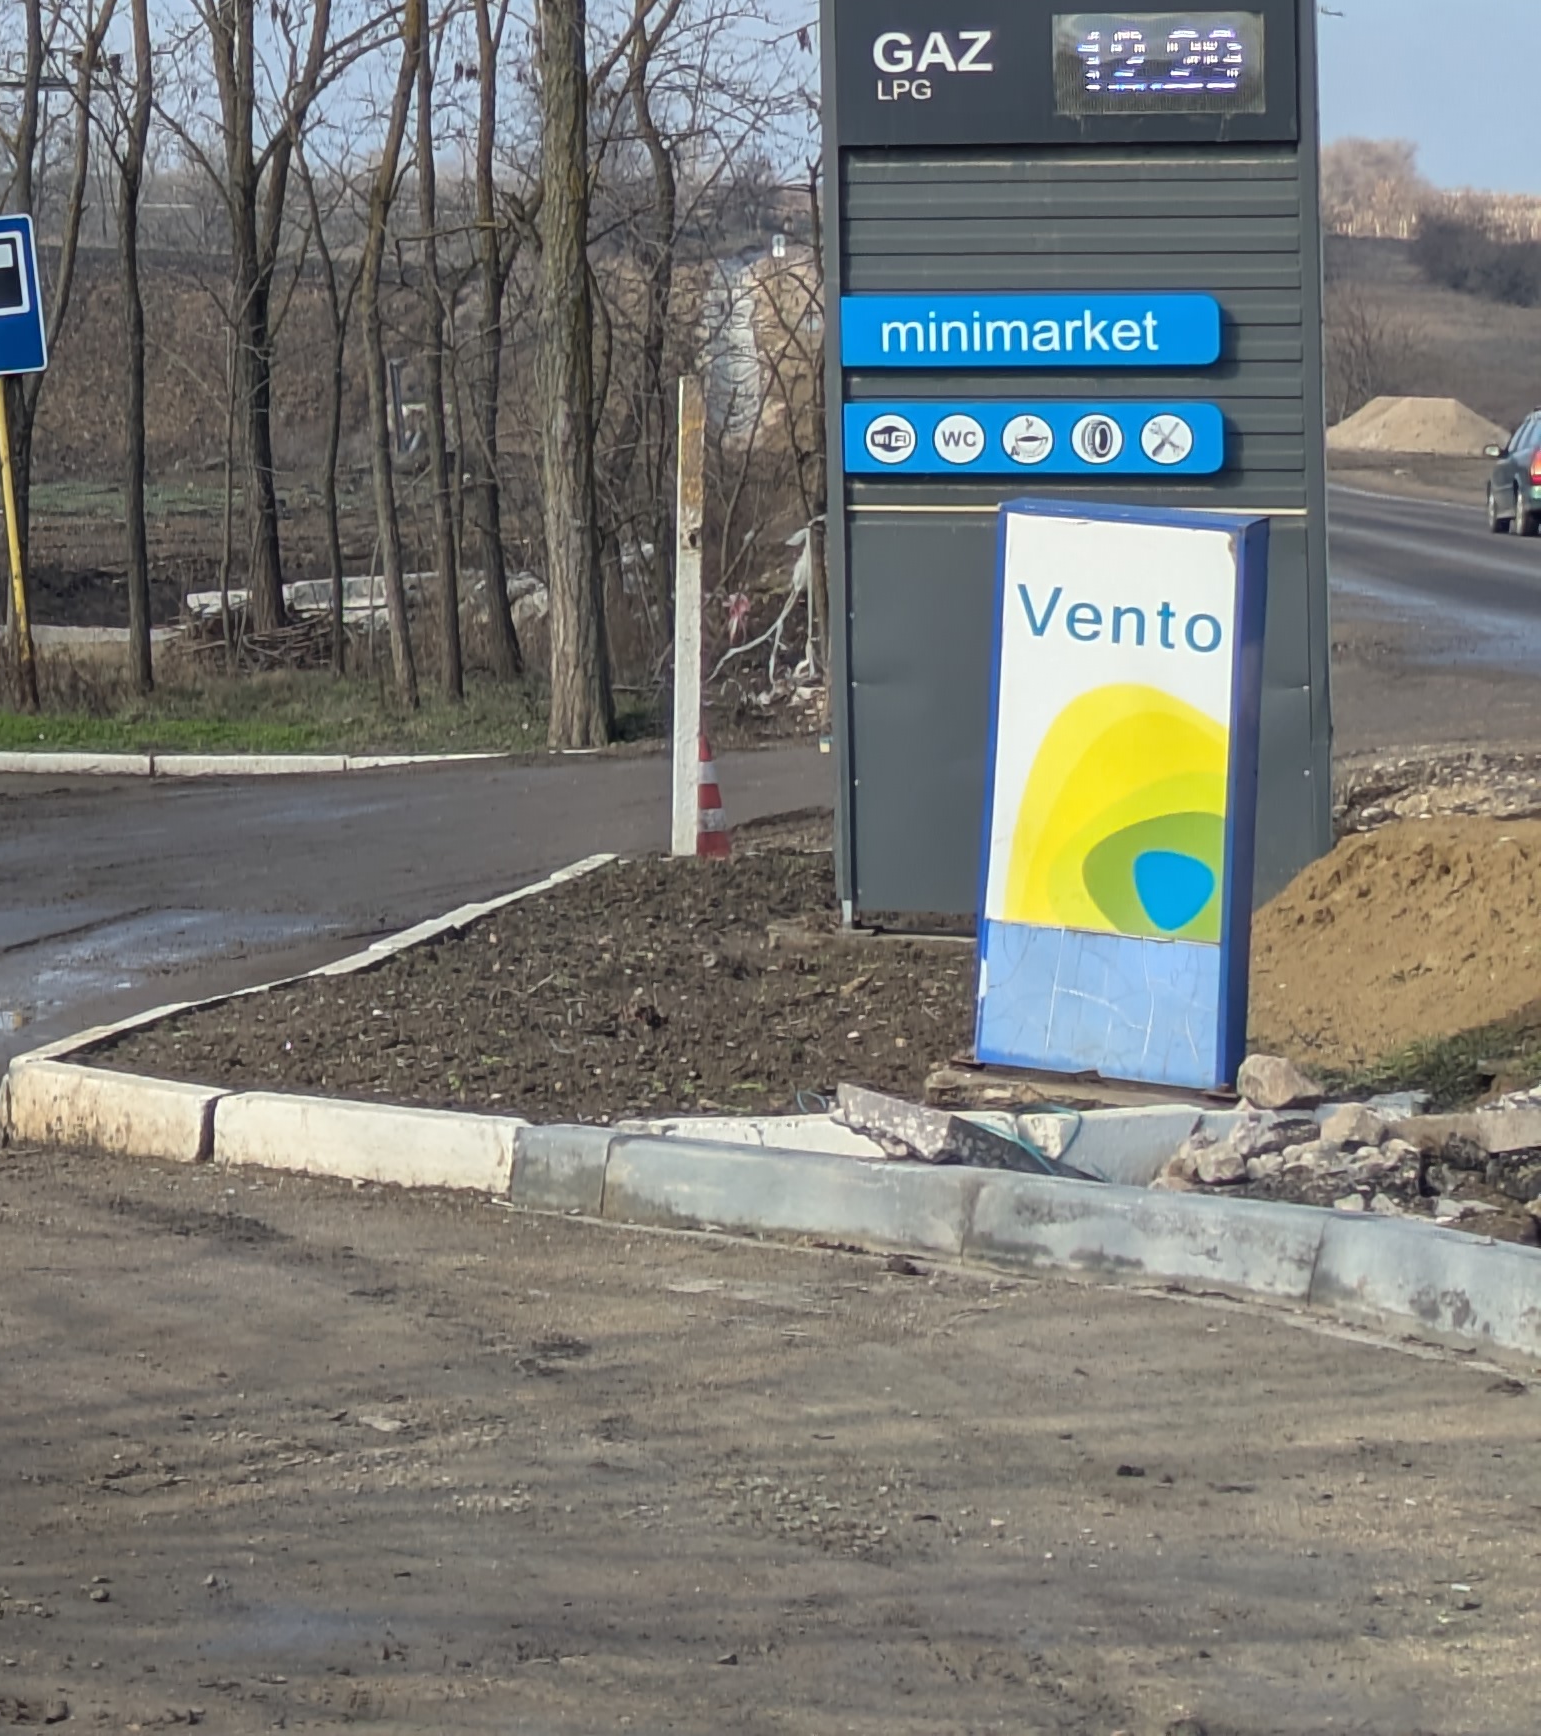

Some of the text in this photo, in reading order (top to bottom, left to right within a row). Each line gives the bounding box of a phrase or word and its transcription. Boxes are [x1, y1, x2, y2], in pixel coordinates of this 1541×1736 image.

[872, 30, 994, 73] GAZ
[876, 78, 933, 101] LPG
[881, 309, 1159, 353] minimarket
[941, 430, 977, 448] WC
[1017, 583, 1223, 653] Vento
